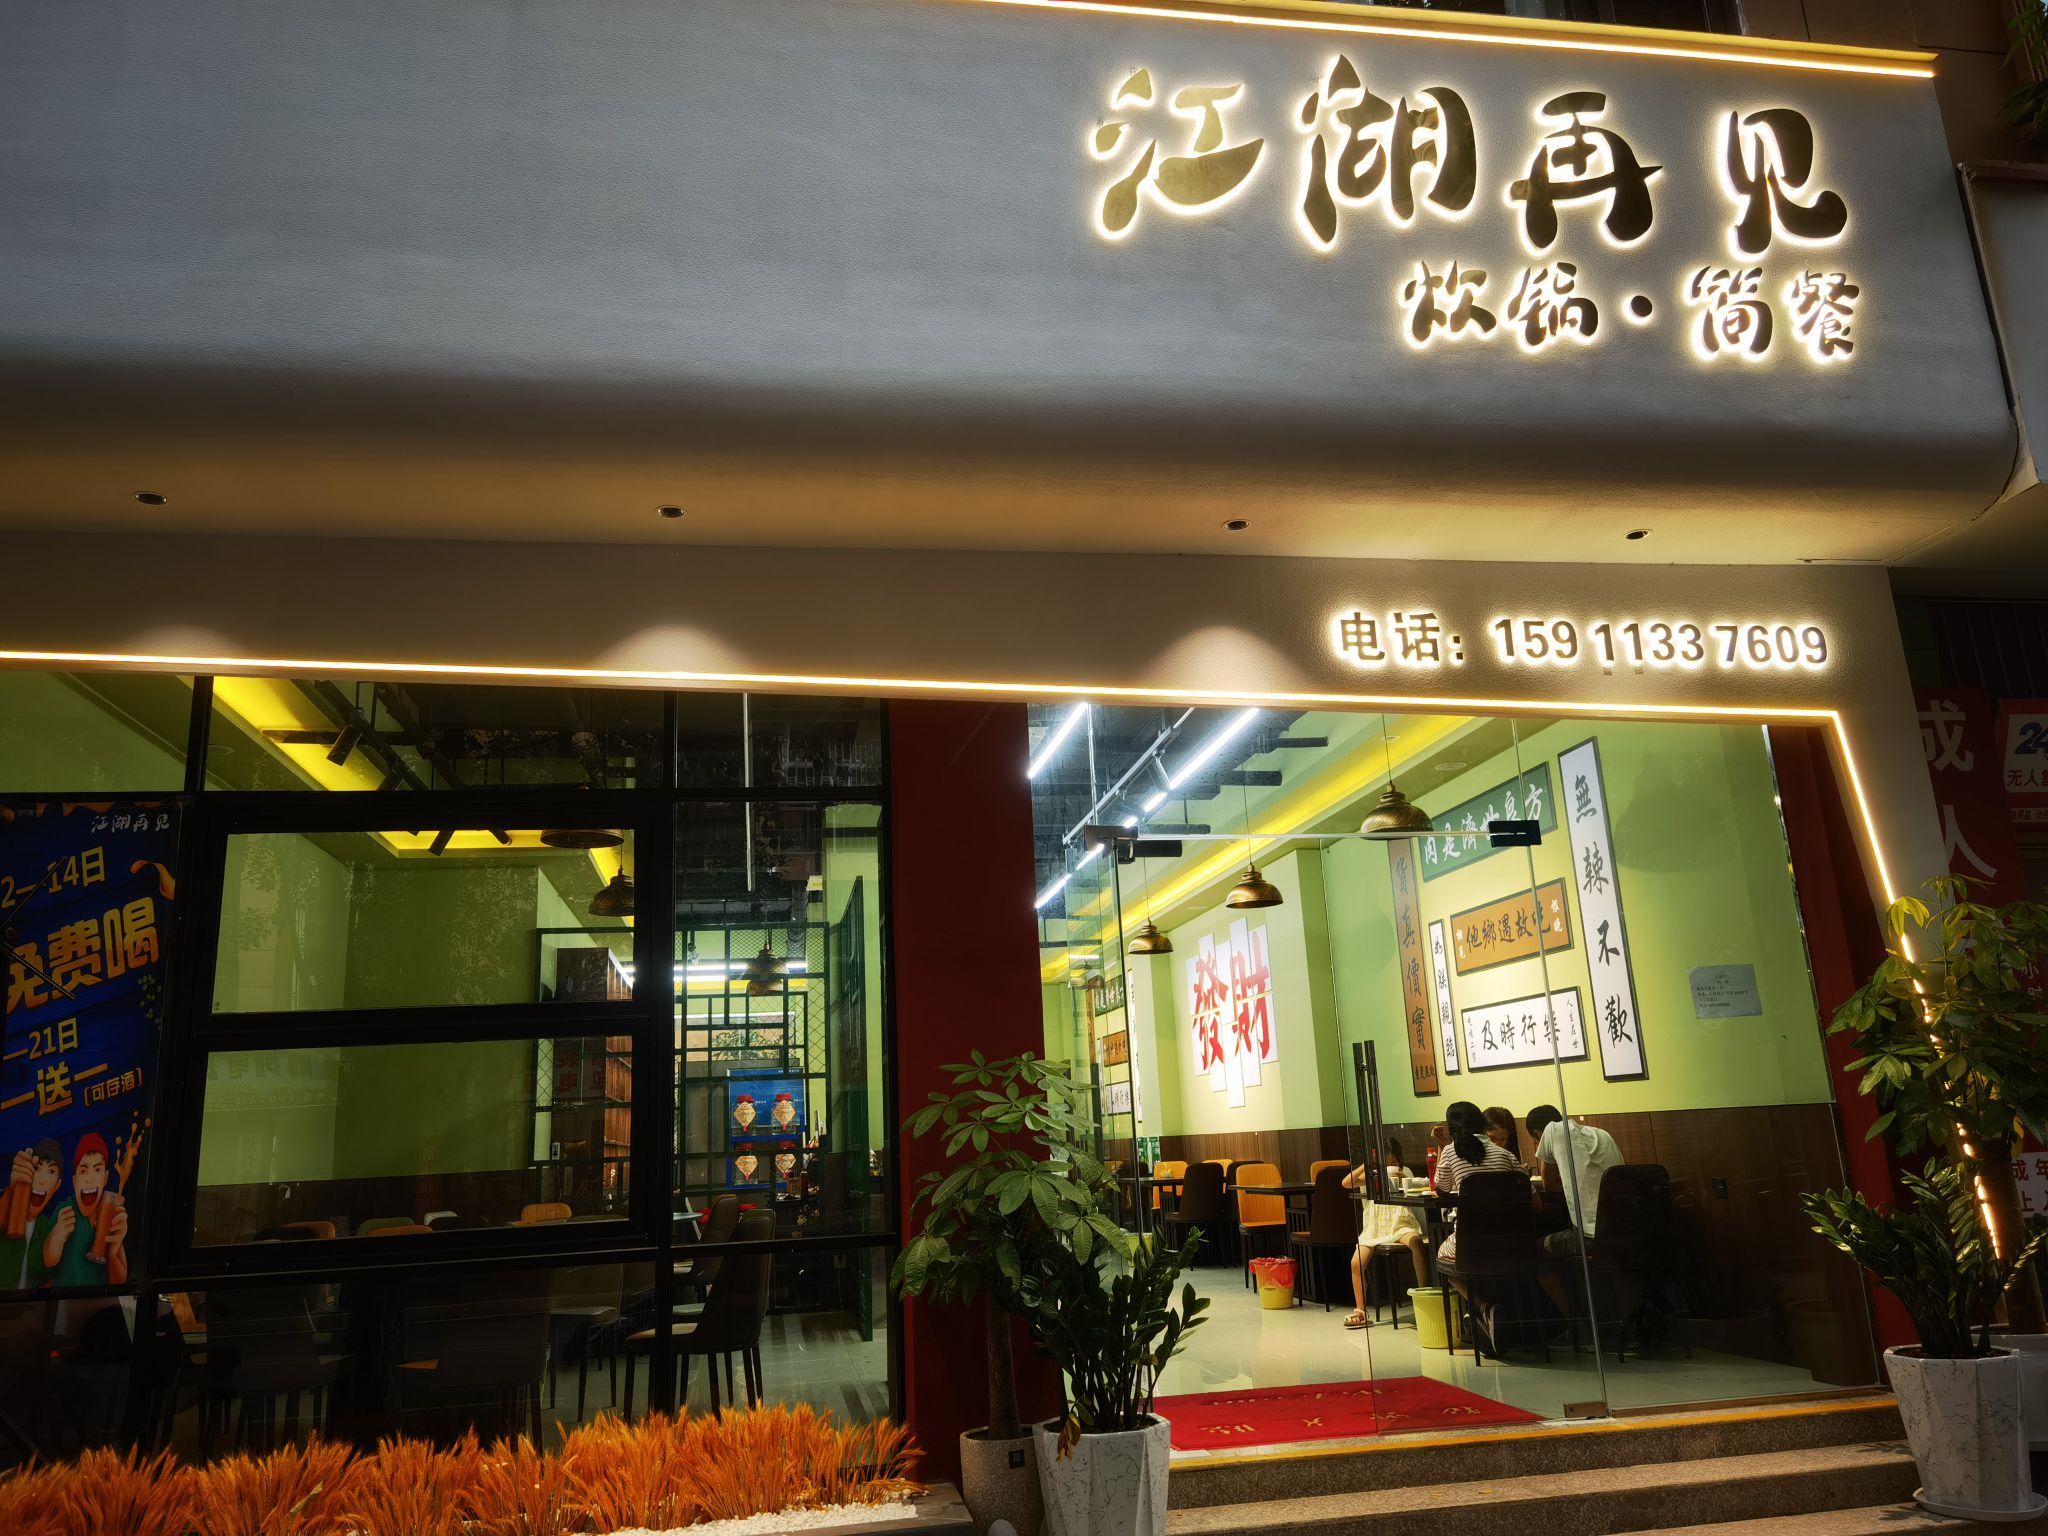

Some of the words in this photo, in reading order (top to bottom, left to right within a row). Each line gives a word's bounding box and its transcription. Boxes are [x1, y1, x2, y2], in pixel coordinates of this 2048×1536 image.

[1090, 54, 1848, 253] 江湖再见
[1494, 618, 1579, 660] 159
[1594, 623, 1703, 662] 1133
[1714, 625, 1828, 664] 7609
[91, 813, 170, 833] 江湖再见
[6, 896, 160, 1016] 免费喝
